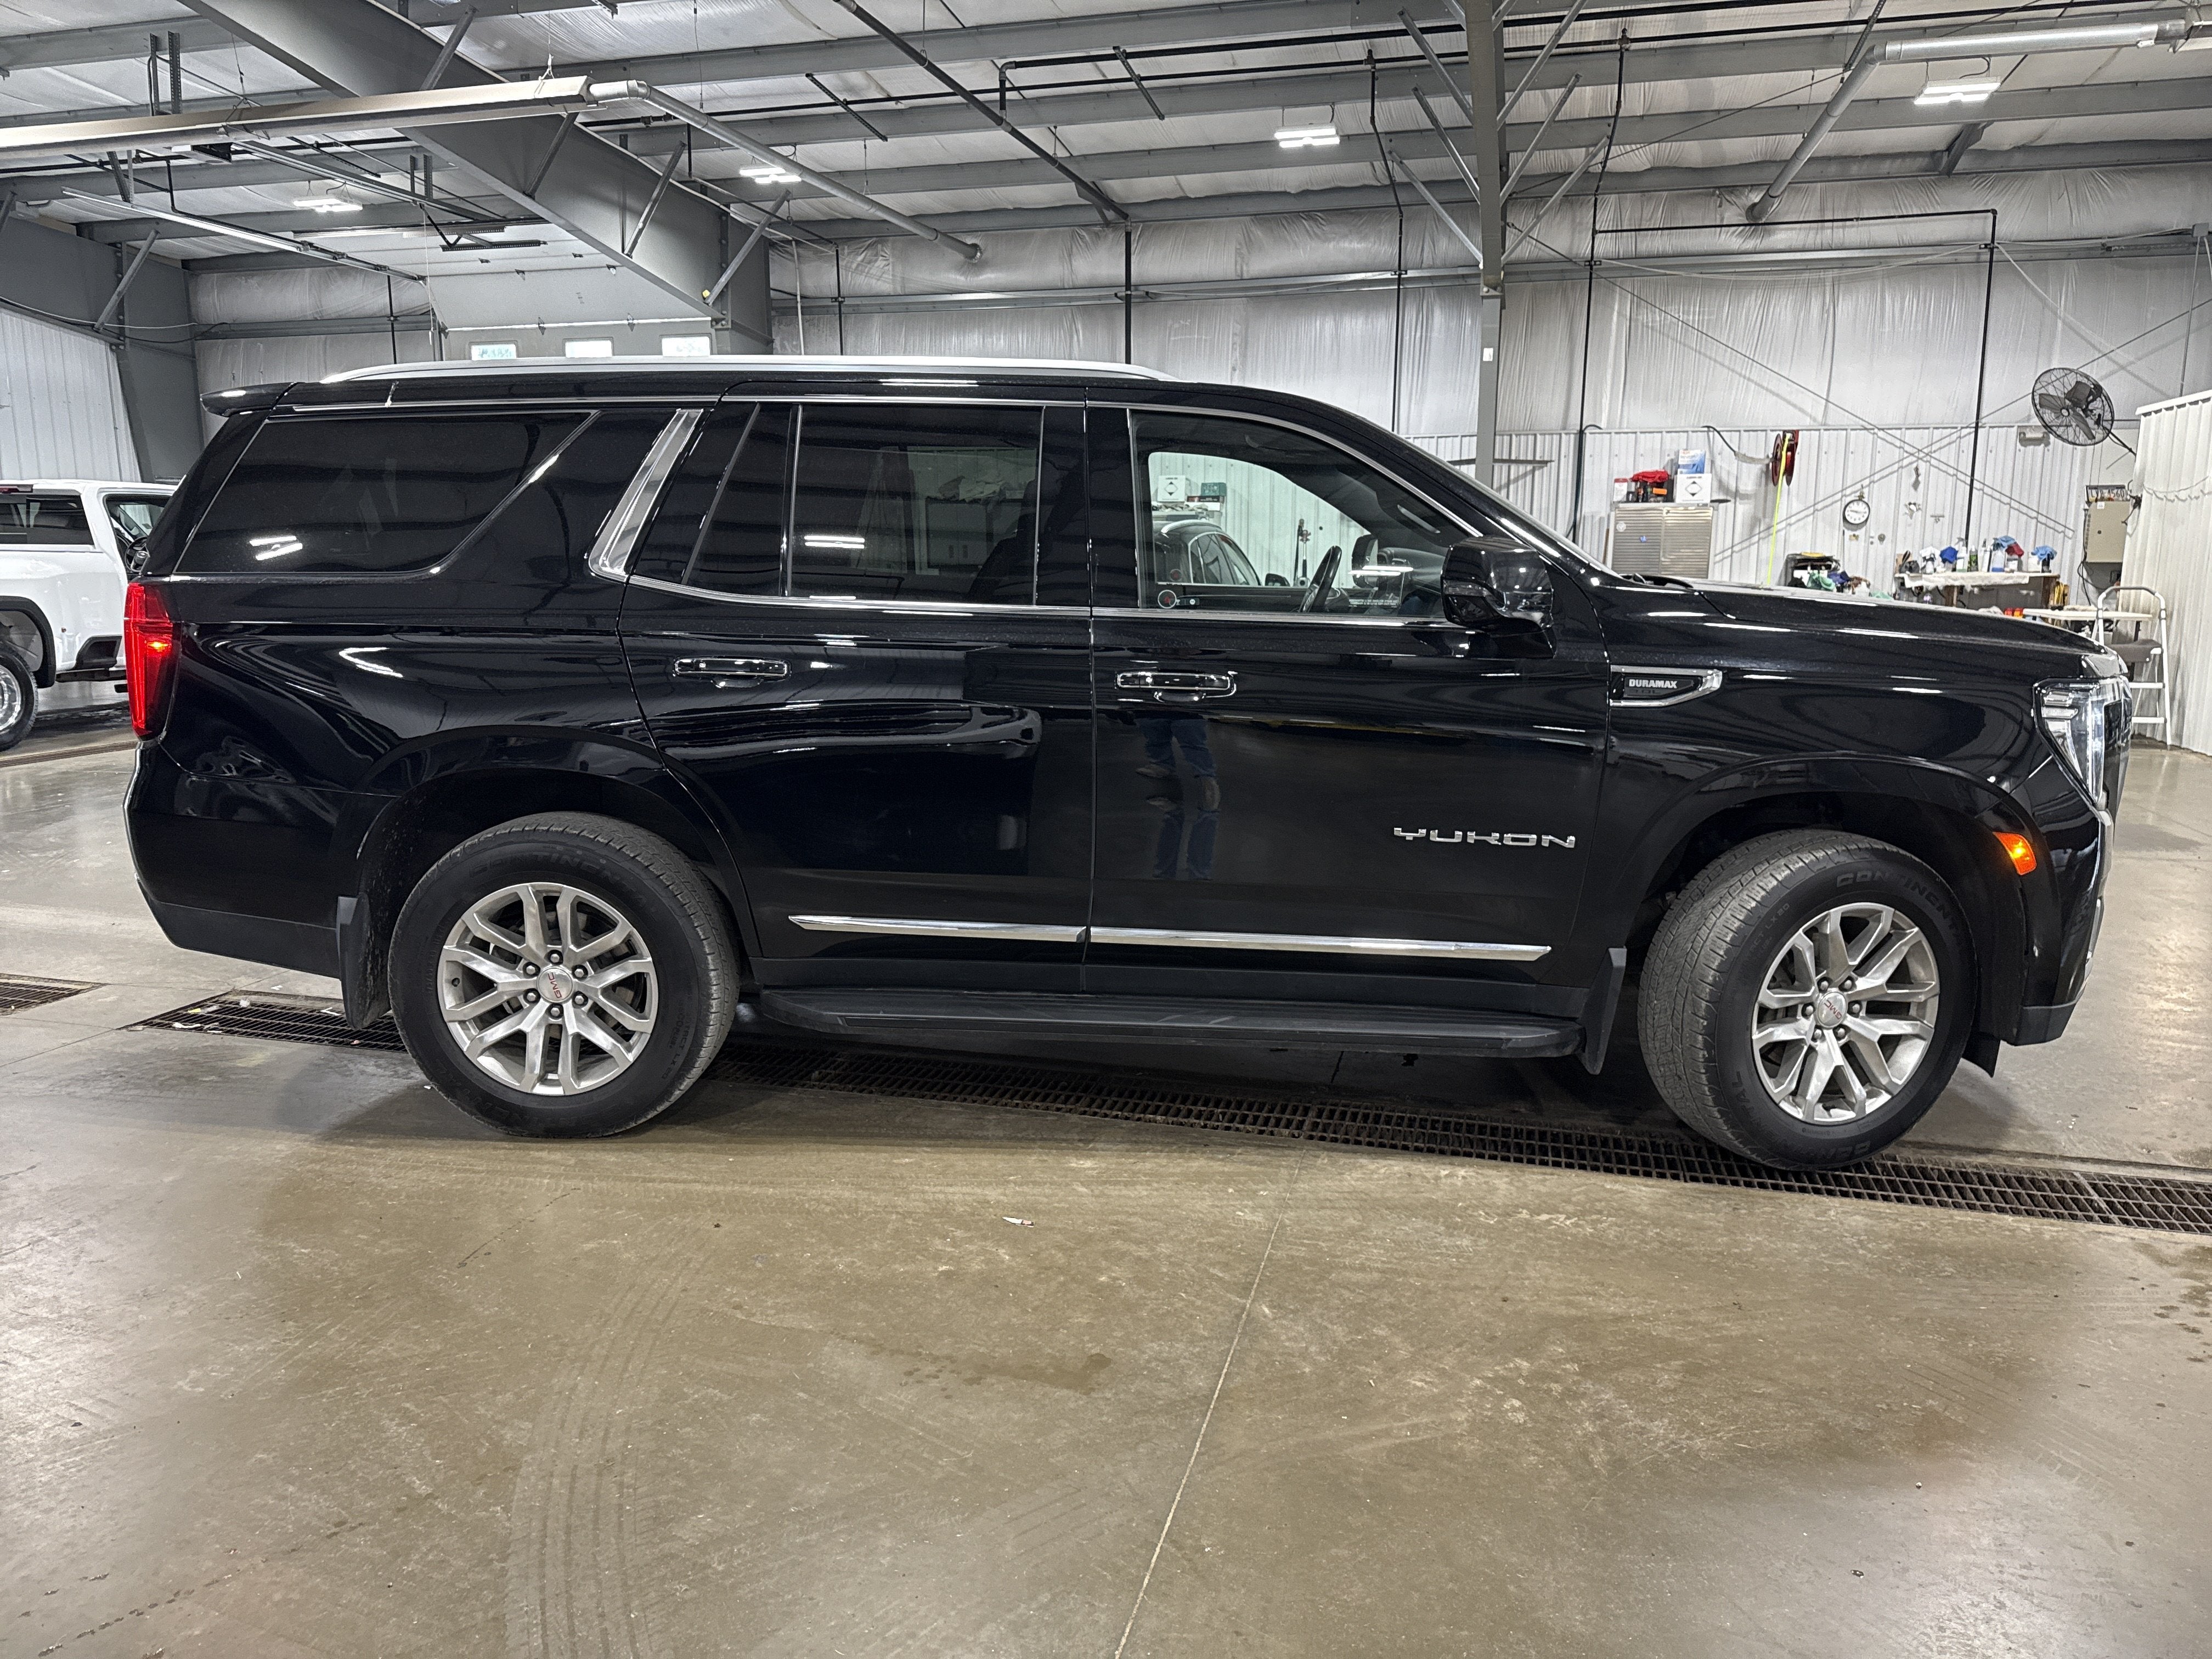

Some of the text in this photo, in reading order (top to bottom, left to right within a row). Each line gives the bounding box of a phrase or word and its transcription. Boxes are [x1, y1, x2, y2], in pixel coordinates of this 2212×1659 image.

[1629, 679, 1677, 689] DURAMAX
[1393, 827, 1575, 848] YUKON
[548, 972, 562, 998] GMC
[1824, 999, 1842, 1020] GMC
